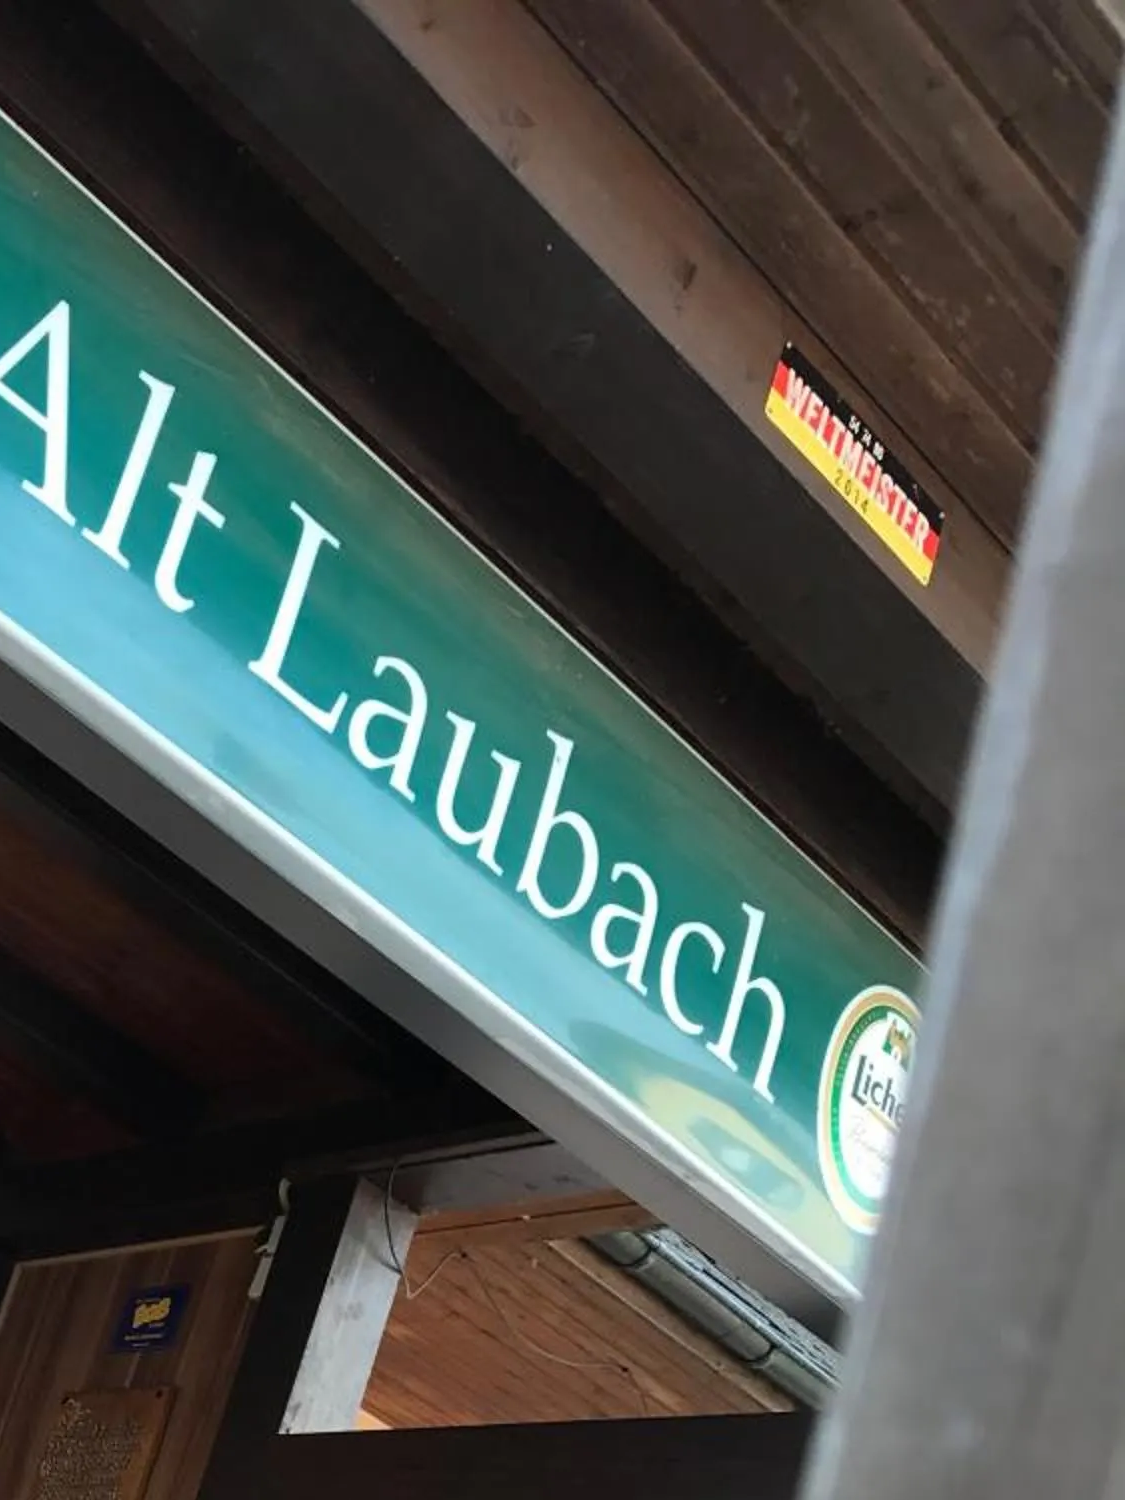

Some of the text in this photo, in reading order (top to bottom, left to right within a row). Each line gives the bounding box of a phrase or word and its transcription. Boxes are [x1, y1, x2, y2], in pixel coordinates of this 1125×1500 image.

[786, 368, 930, 555] WELTMEISTER
[833, 469, 870, 515] 2014
[248, 501, 787, 1104] Laubach
[851, 1054, 908, 1127] Liche
